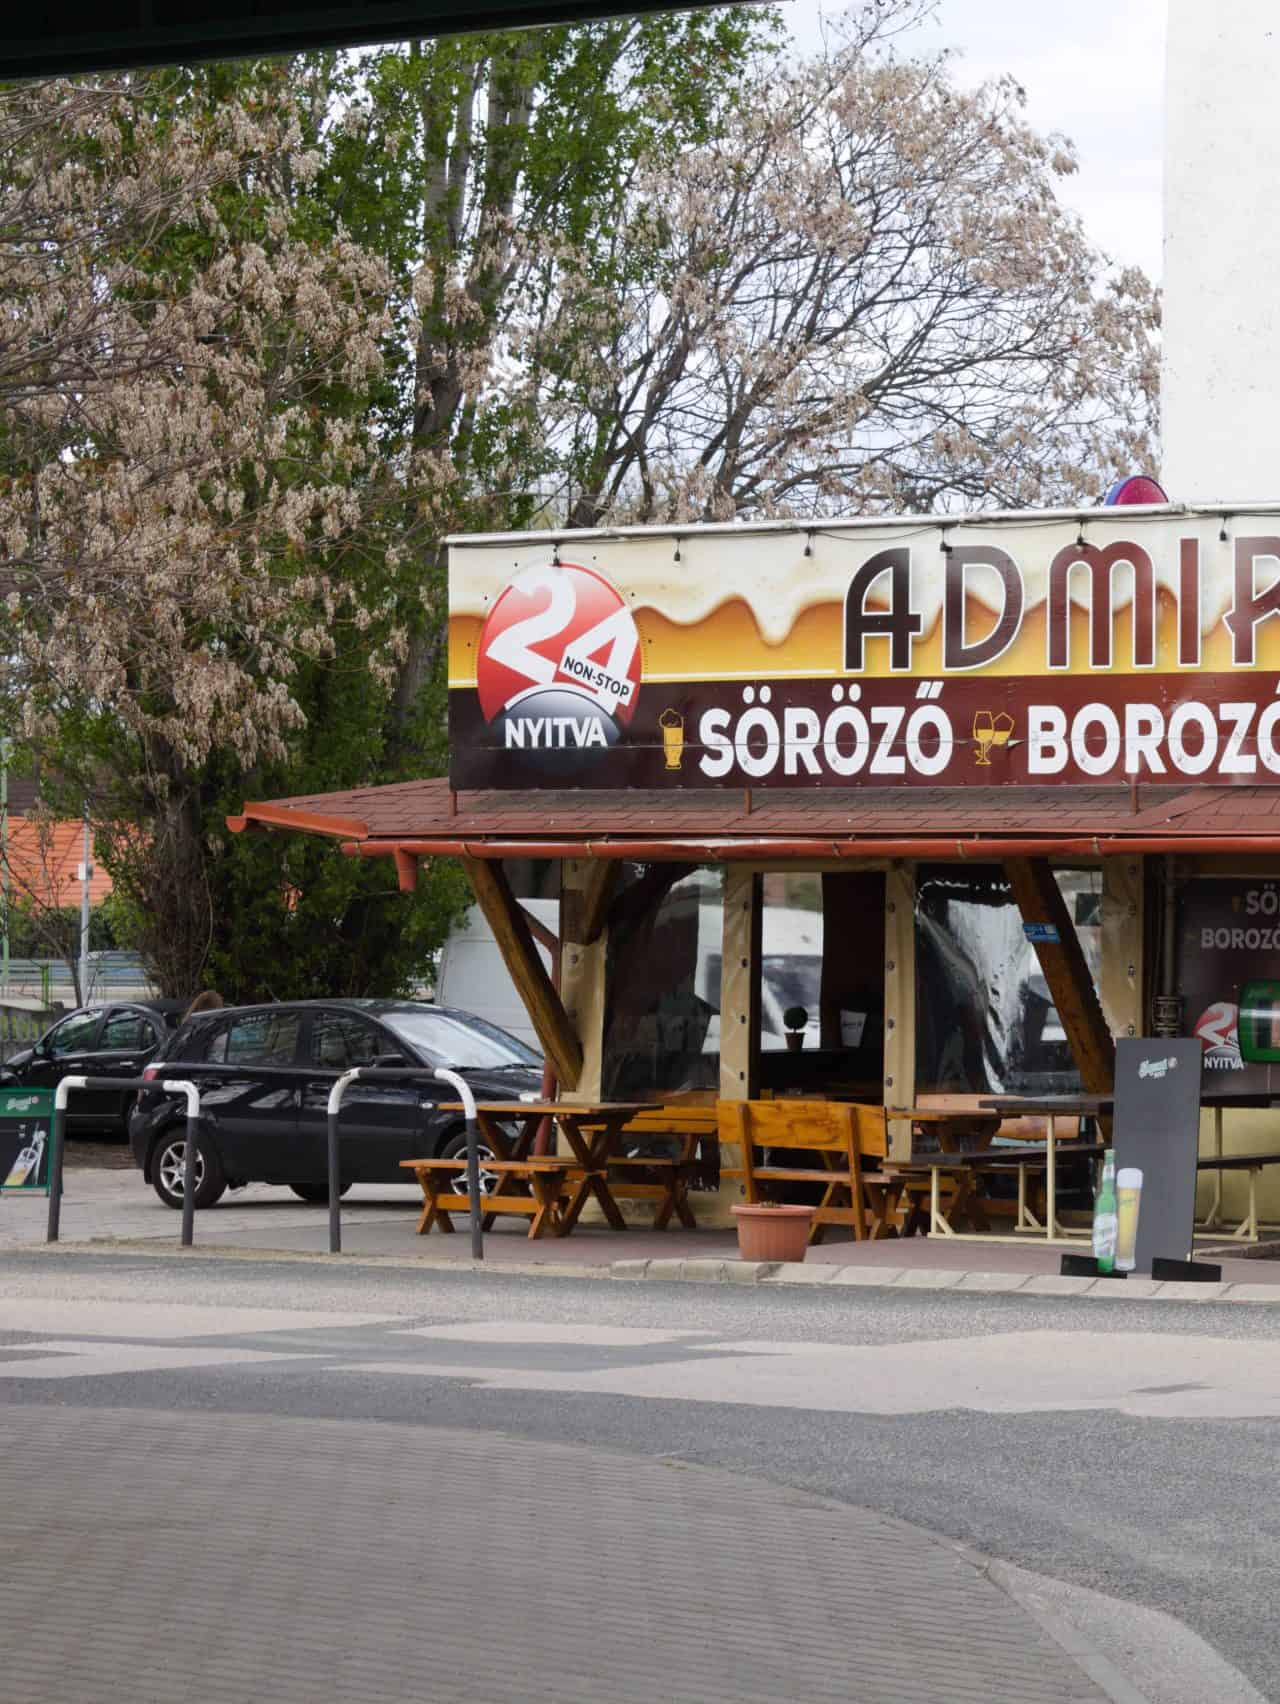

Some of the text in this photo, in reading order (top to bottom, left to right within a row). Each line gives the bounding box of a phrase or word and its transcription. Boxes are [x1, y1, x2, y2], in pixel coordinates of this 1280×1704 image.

[486, 564, 640, 716] 24
[563, 656, 630, 698] NON-STOP
[504, 716, 609, 749] NYITVA
[699, 682, 953, 778] SÖRÖZŐ
[1203, 1056, 1245, 1070] NYITVA
